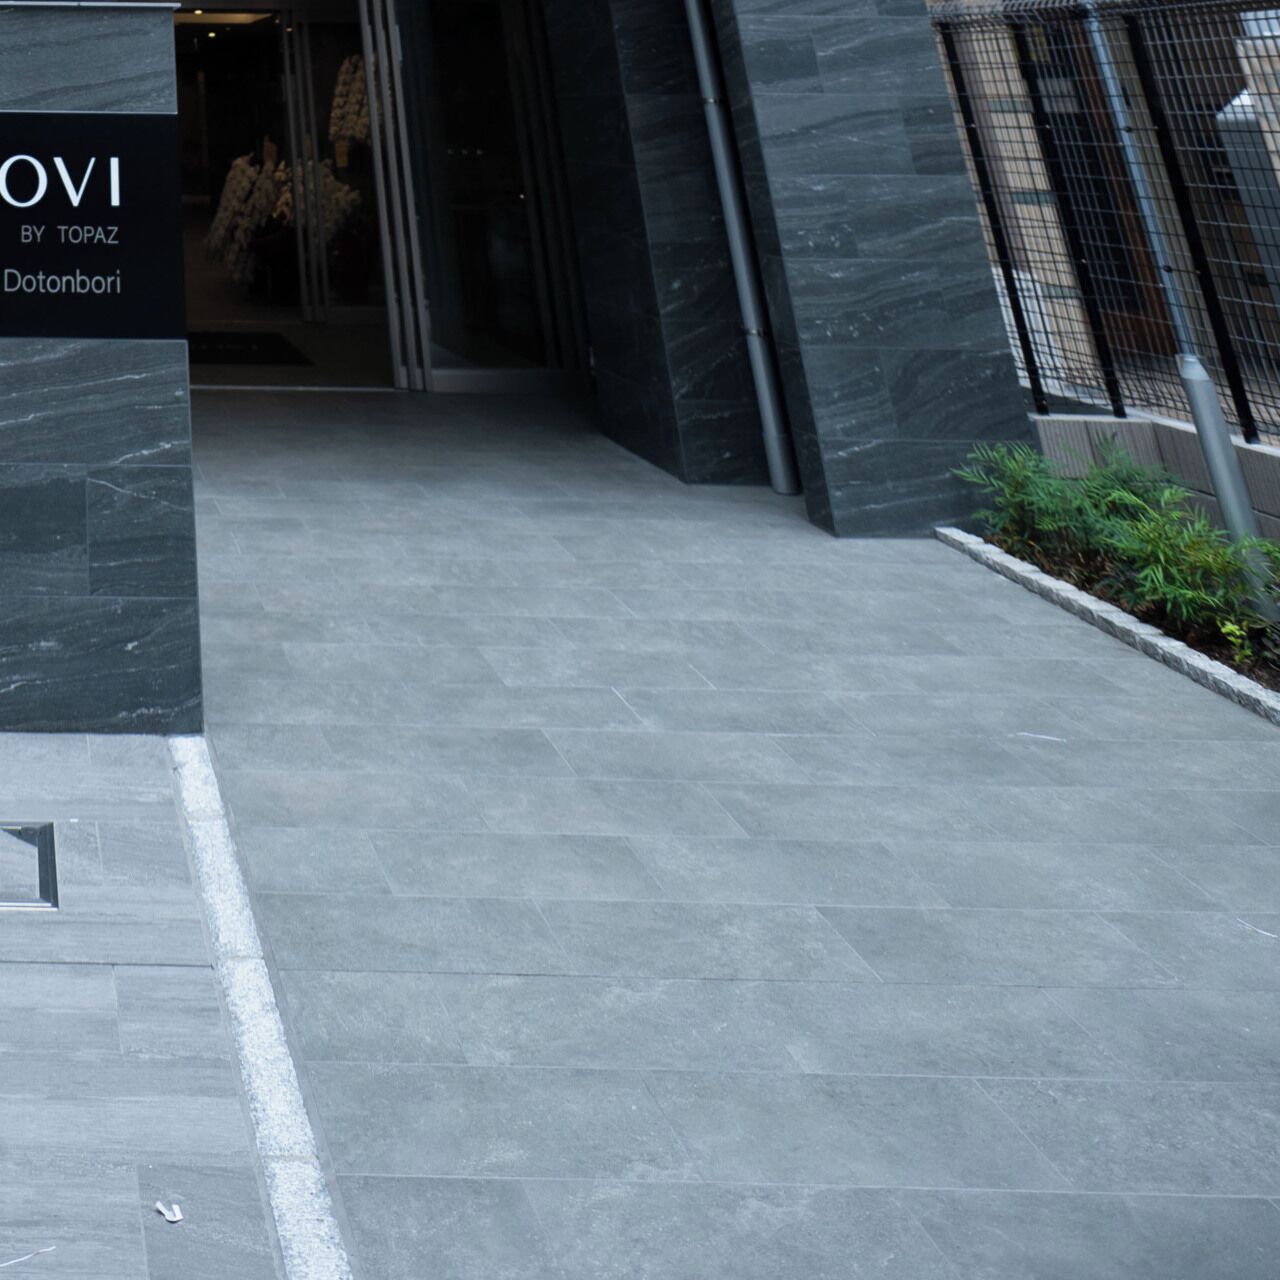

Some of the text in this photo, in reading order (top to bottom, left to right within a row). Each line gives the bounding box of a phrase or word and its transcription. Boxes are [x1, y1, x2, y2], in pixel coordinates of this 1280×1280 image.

[20, 225, 119, 244] BY TOPAZ
[3, 268, 121, 294] Dotonbori
